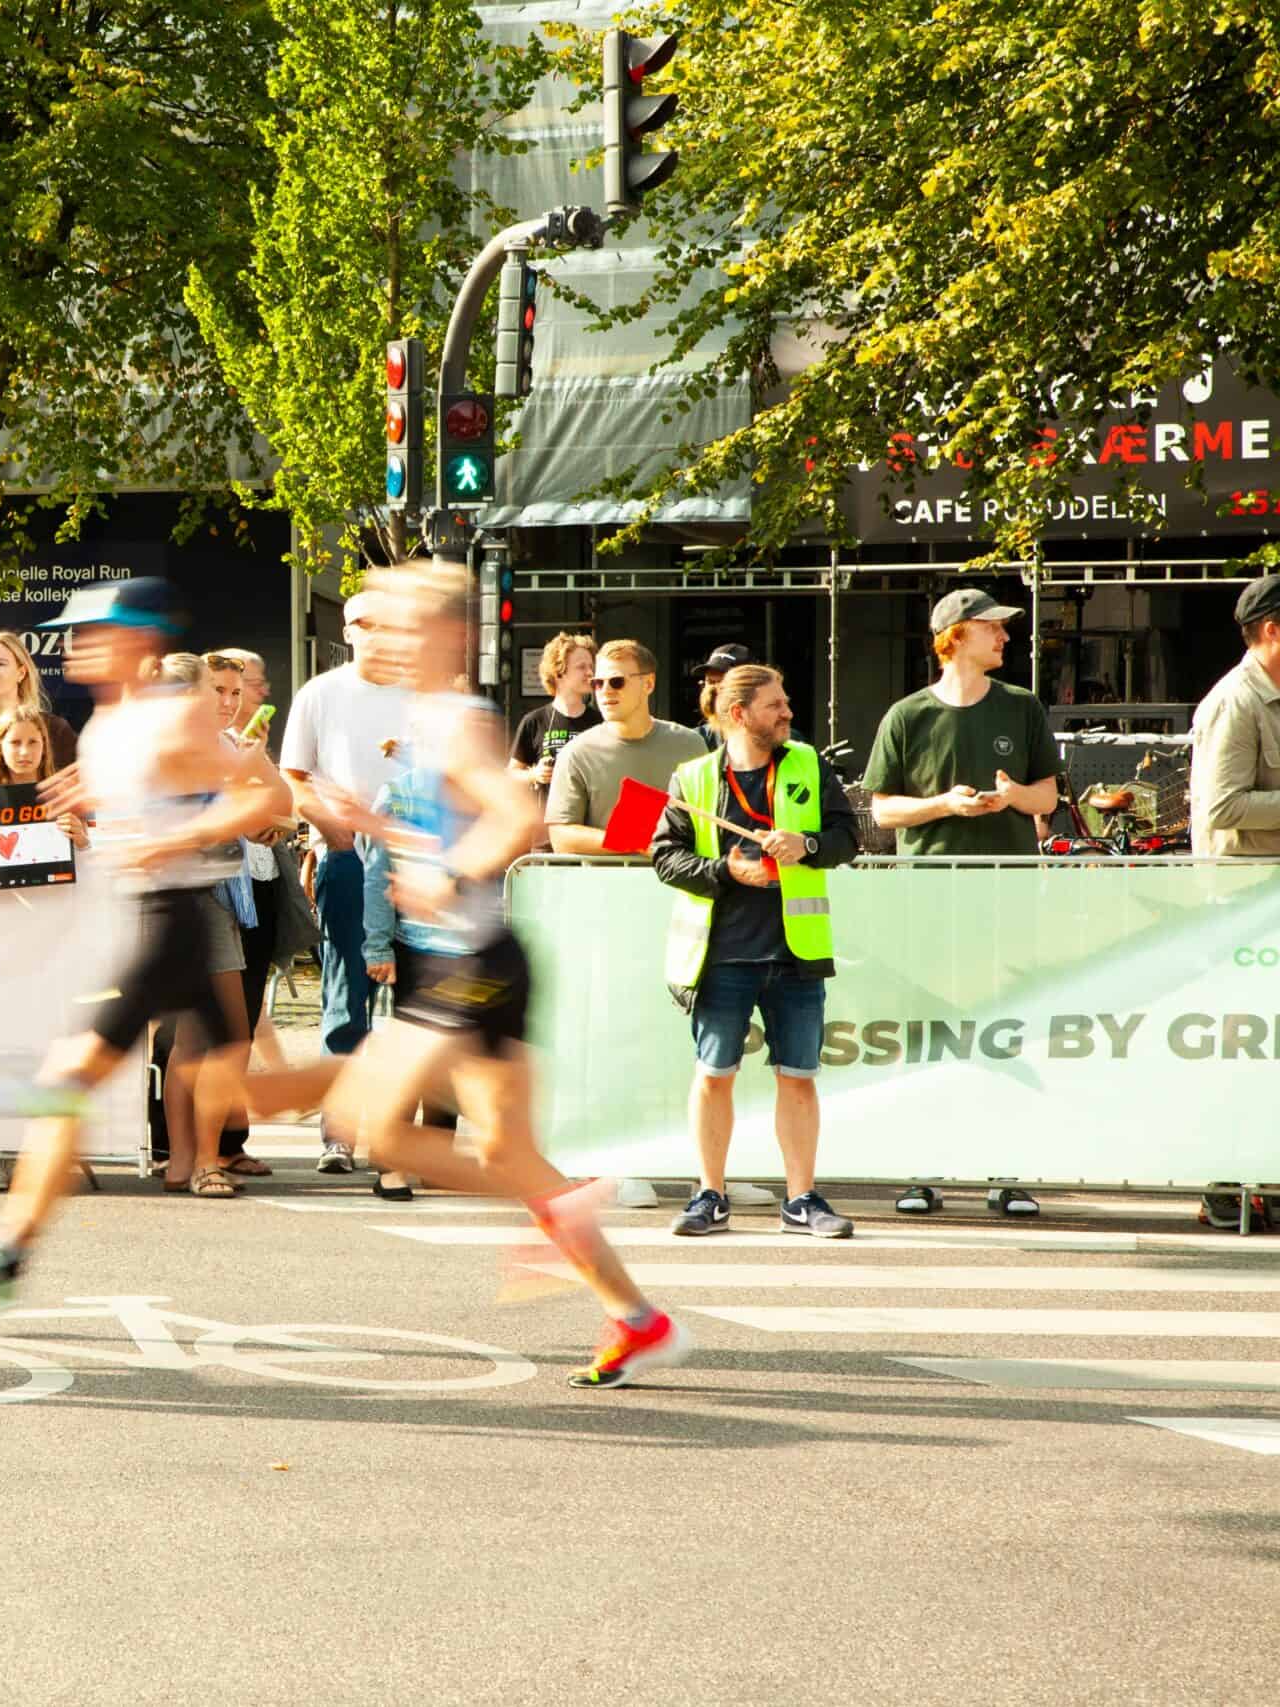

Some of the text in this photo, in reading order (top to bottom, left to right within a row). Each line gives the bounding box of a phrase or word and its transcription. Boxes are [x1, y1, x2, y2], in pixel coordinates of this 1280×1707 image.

[895, 491, 972, 524] CAFÉ
[52, 565, 95, 582] Royal
[99, 564, 131, 579] Run
[1048, 1013, 1147, 1060] BY
[1167, 1012, 1280, 1060] GR
